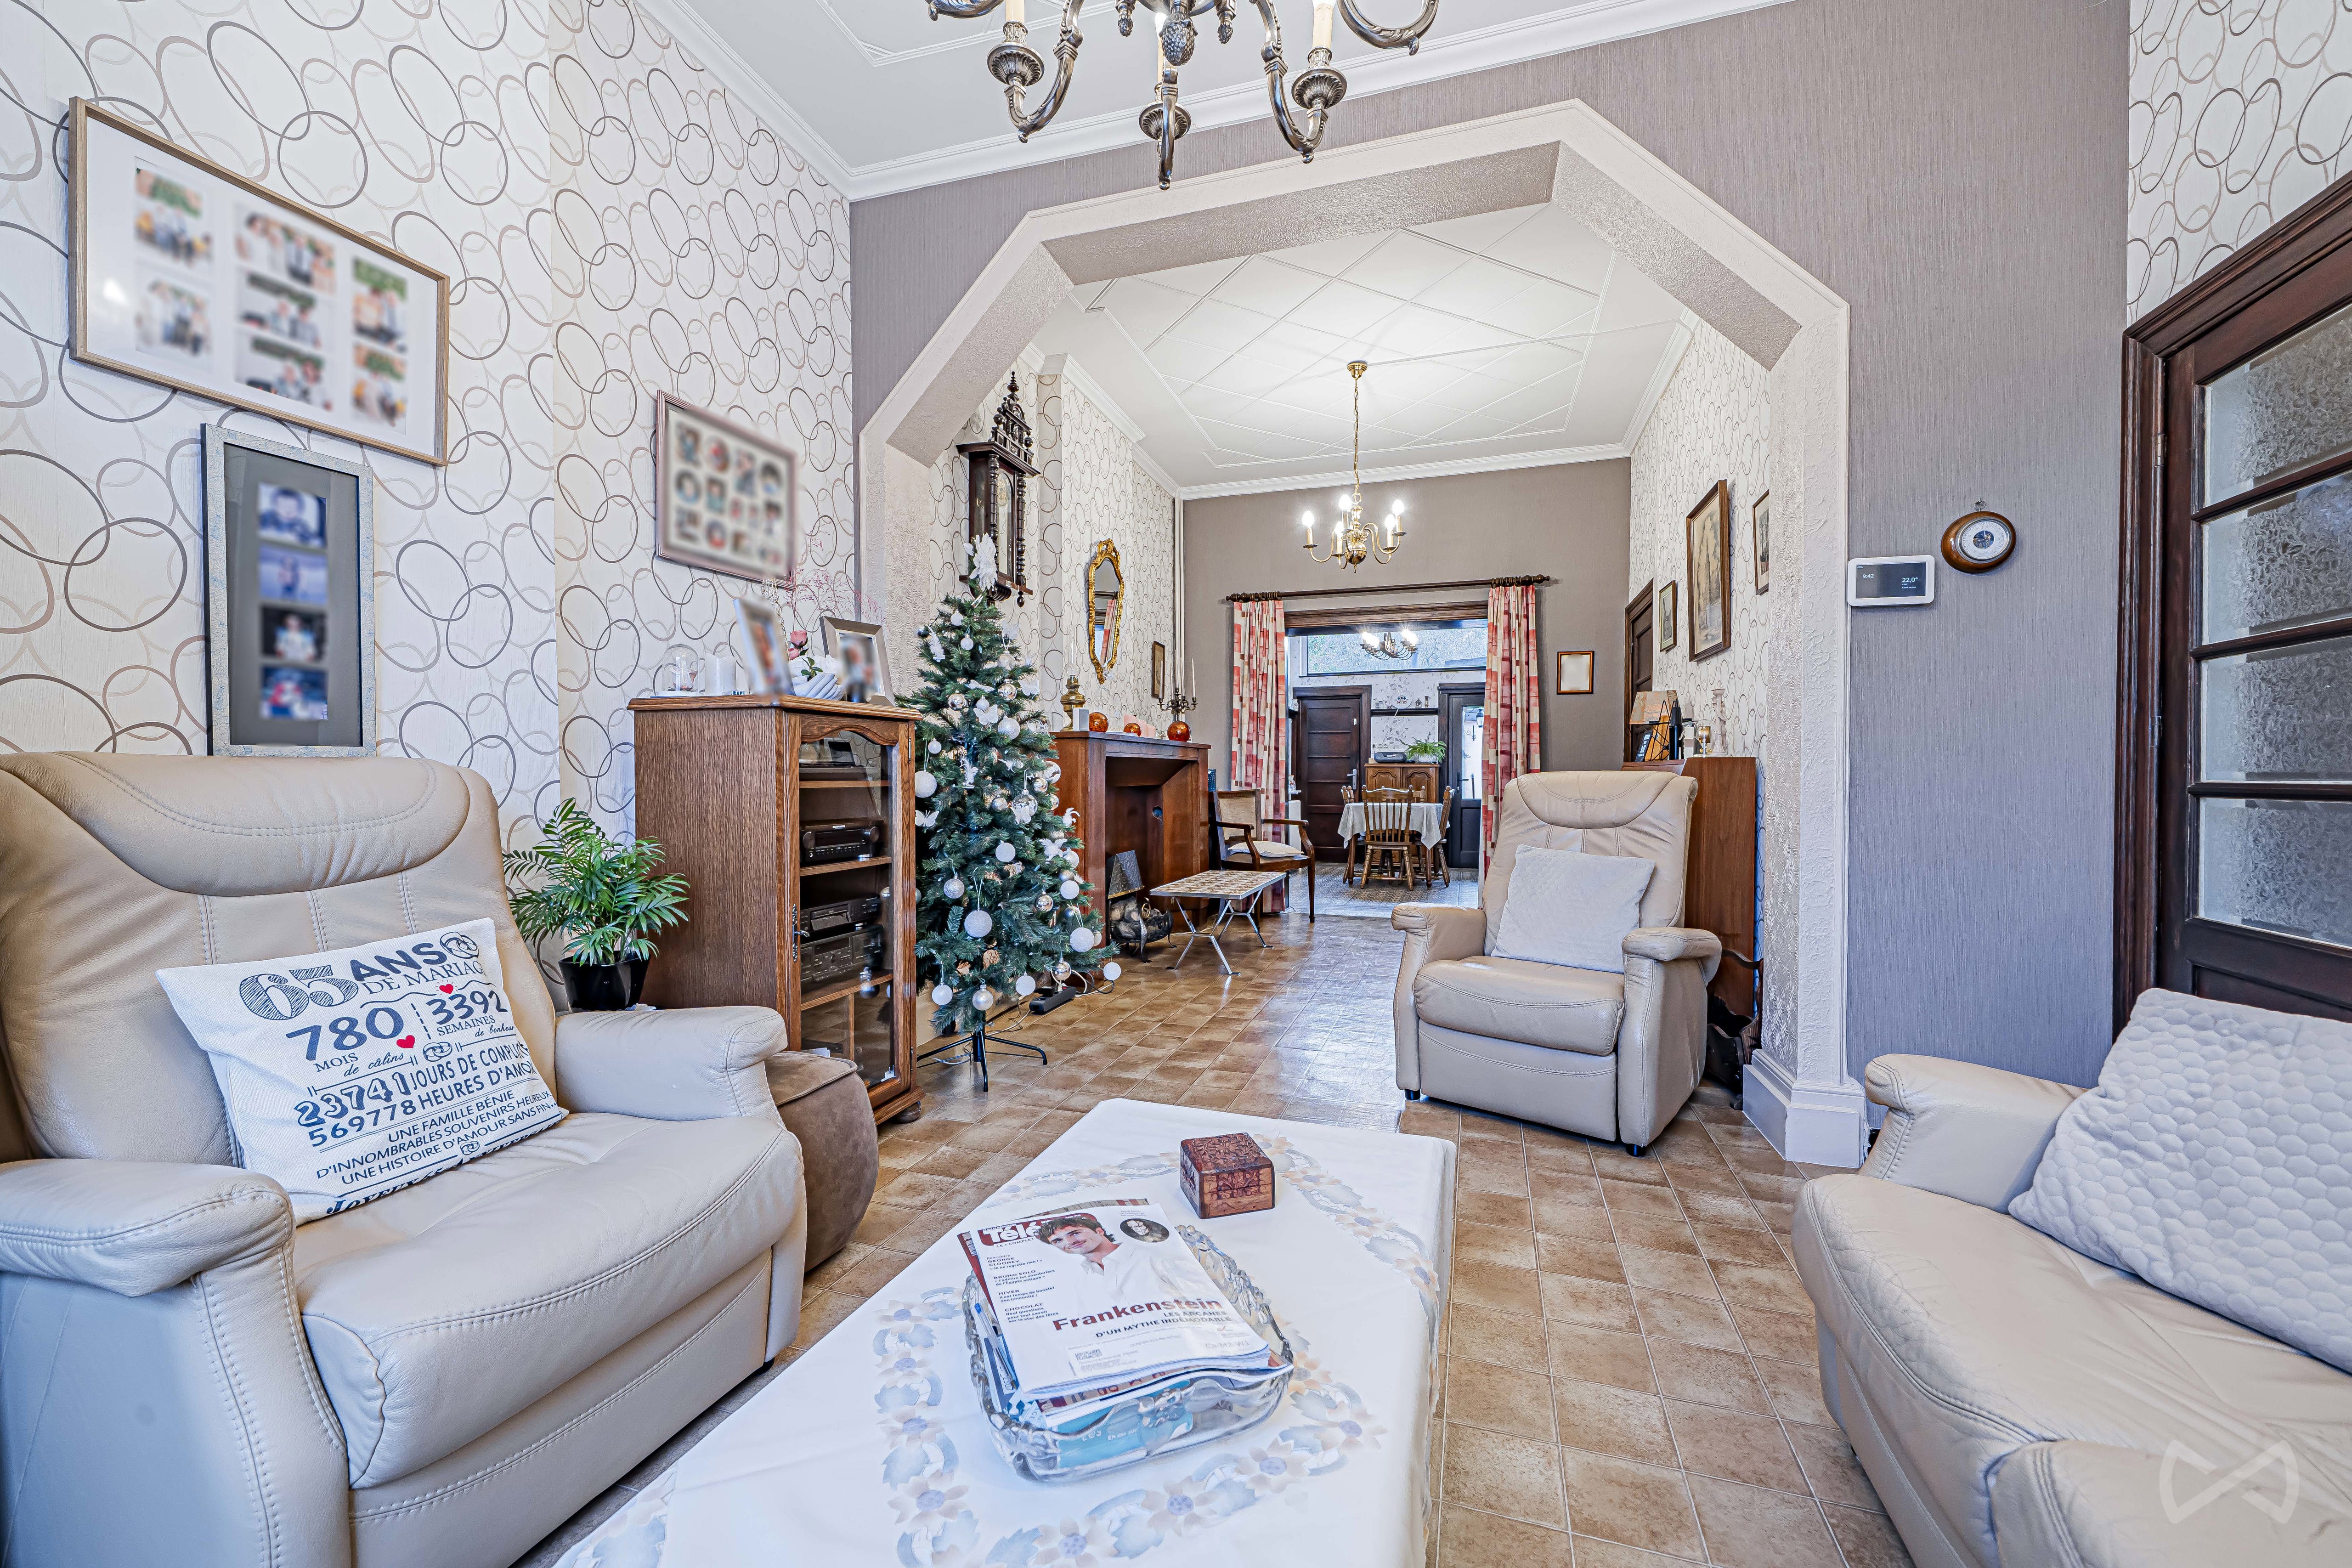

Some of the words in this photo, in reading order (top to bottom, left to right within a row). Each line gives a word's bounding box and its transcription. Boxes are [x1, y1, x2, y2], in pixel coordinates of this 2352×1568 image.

[350, 942, 447, 982] ANS
[239, 964, 359, 1020] 65
[360, 977, 401, 995] DE
[426, 990, 508, 1025] 3392
[286, 1007, 404, 1061] 780
[437, 1015, 496, 1036] SEMAINES
[475, 1028, 484, 1037] de
[489, 1023, 514, 1034] bonheur
[313, 1053, 358, 1073] MOIS
[344, 1064, 359, 1076] de
[368, 1052, 404, 1070] câlins
[294, 1072, 411, 1127] 23741
[410, 1060, 455, 1090] JOURS
[457, 1054, 478, 1075] DE
[308, 1099, 416, 1147] 569778
[418, 1075, 484, 1110] HEURES
[389, 1124, 419, 1143] UNE
[422, 1106, 474, 1131] FAMILLE
[476, 1090, 515, 1111] BÉNIE
[317, 1130, 442, 1179] D'INNOMBRABLES
[446, 1102, 515, 1136] SOUVENIRS
[516, 1091, 552, 1108] HEUREUX
[341, 1166, 376, 1184] UNE
[379, 1144, 442, 1174] HISTOIRE
[443, 1120, 507, 1149] D'AMOUR
[508, 1107, 536, 1125] SANS
[1005, 1303, 1043, 1312] CHOCOLAT
[1052, 1298, 1223, 1330] Frankenstein
[1096, 1328, 1121, 1337] D'UN
[1124, 1319, 1159, 1331] MYTHE
